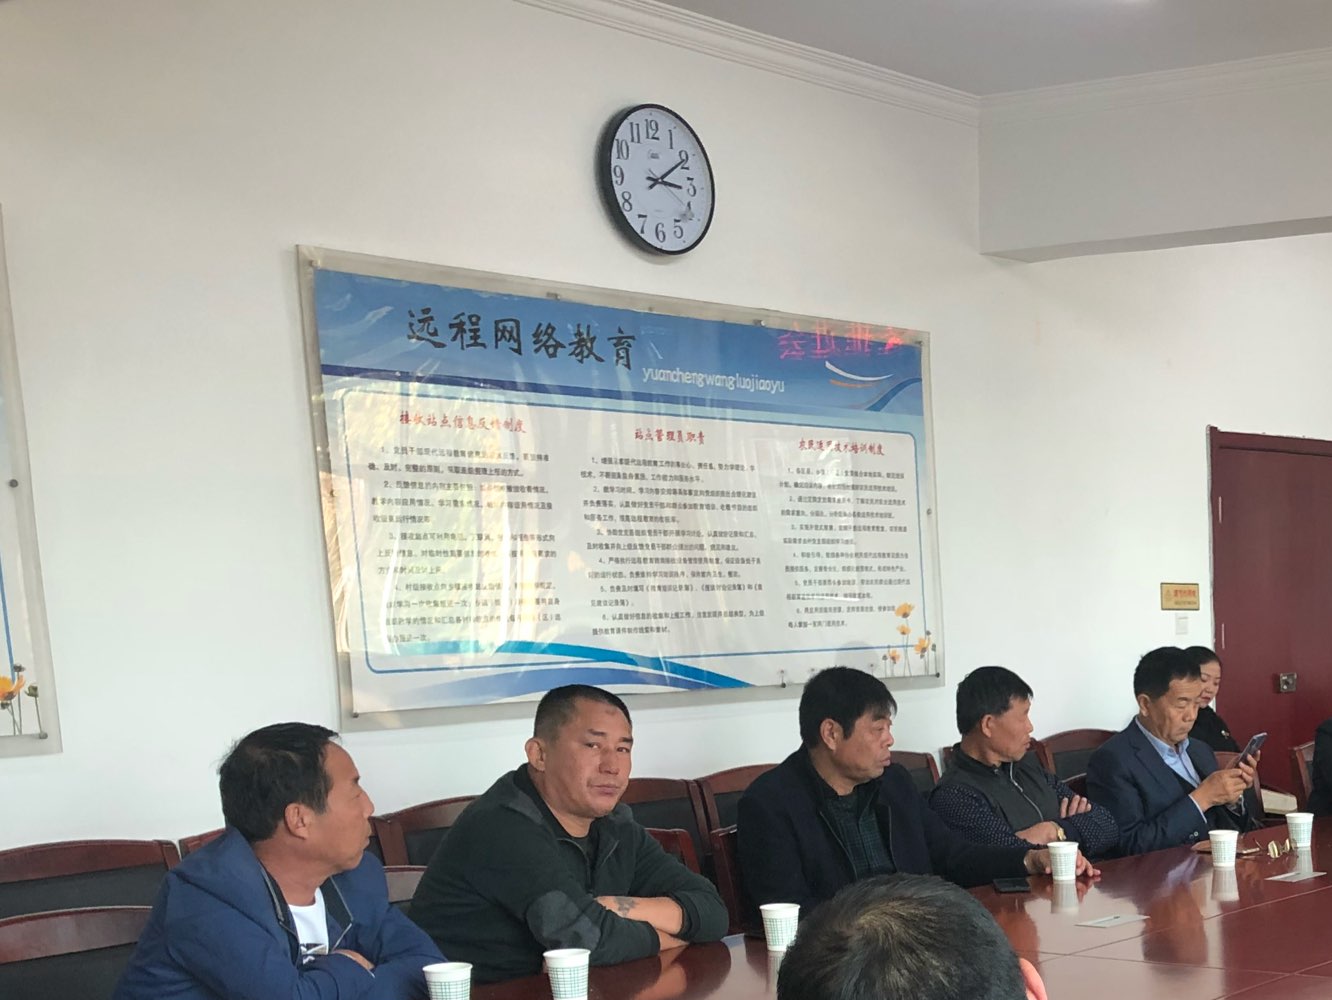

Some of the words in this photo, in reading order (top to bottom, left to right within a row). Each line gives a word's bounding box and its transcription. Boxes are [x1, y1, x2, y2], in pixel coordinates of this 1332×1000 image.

[629, 122, 641, 144] 11
[645, 119, 660, 140] 12
[668, 129, 674, 149] 1
[615, 139, 629, 160] 10
[679, 150, 690, 170] 2
[613, 165, 624, 186] 9
[687, 177, 697, 197] 3
[622, 191, 632, 212] 8
[638, 214, 647, 234] 7
[655, 223, 666, 243] 6
[674, 218, 683, 239] 5
[407, 307, 636, 370] 远程网络教育
[642, 367, 785, 394] yuanchengwangluojiaoyu
[635, 428, 705, 445] 站点管理员职责
